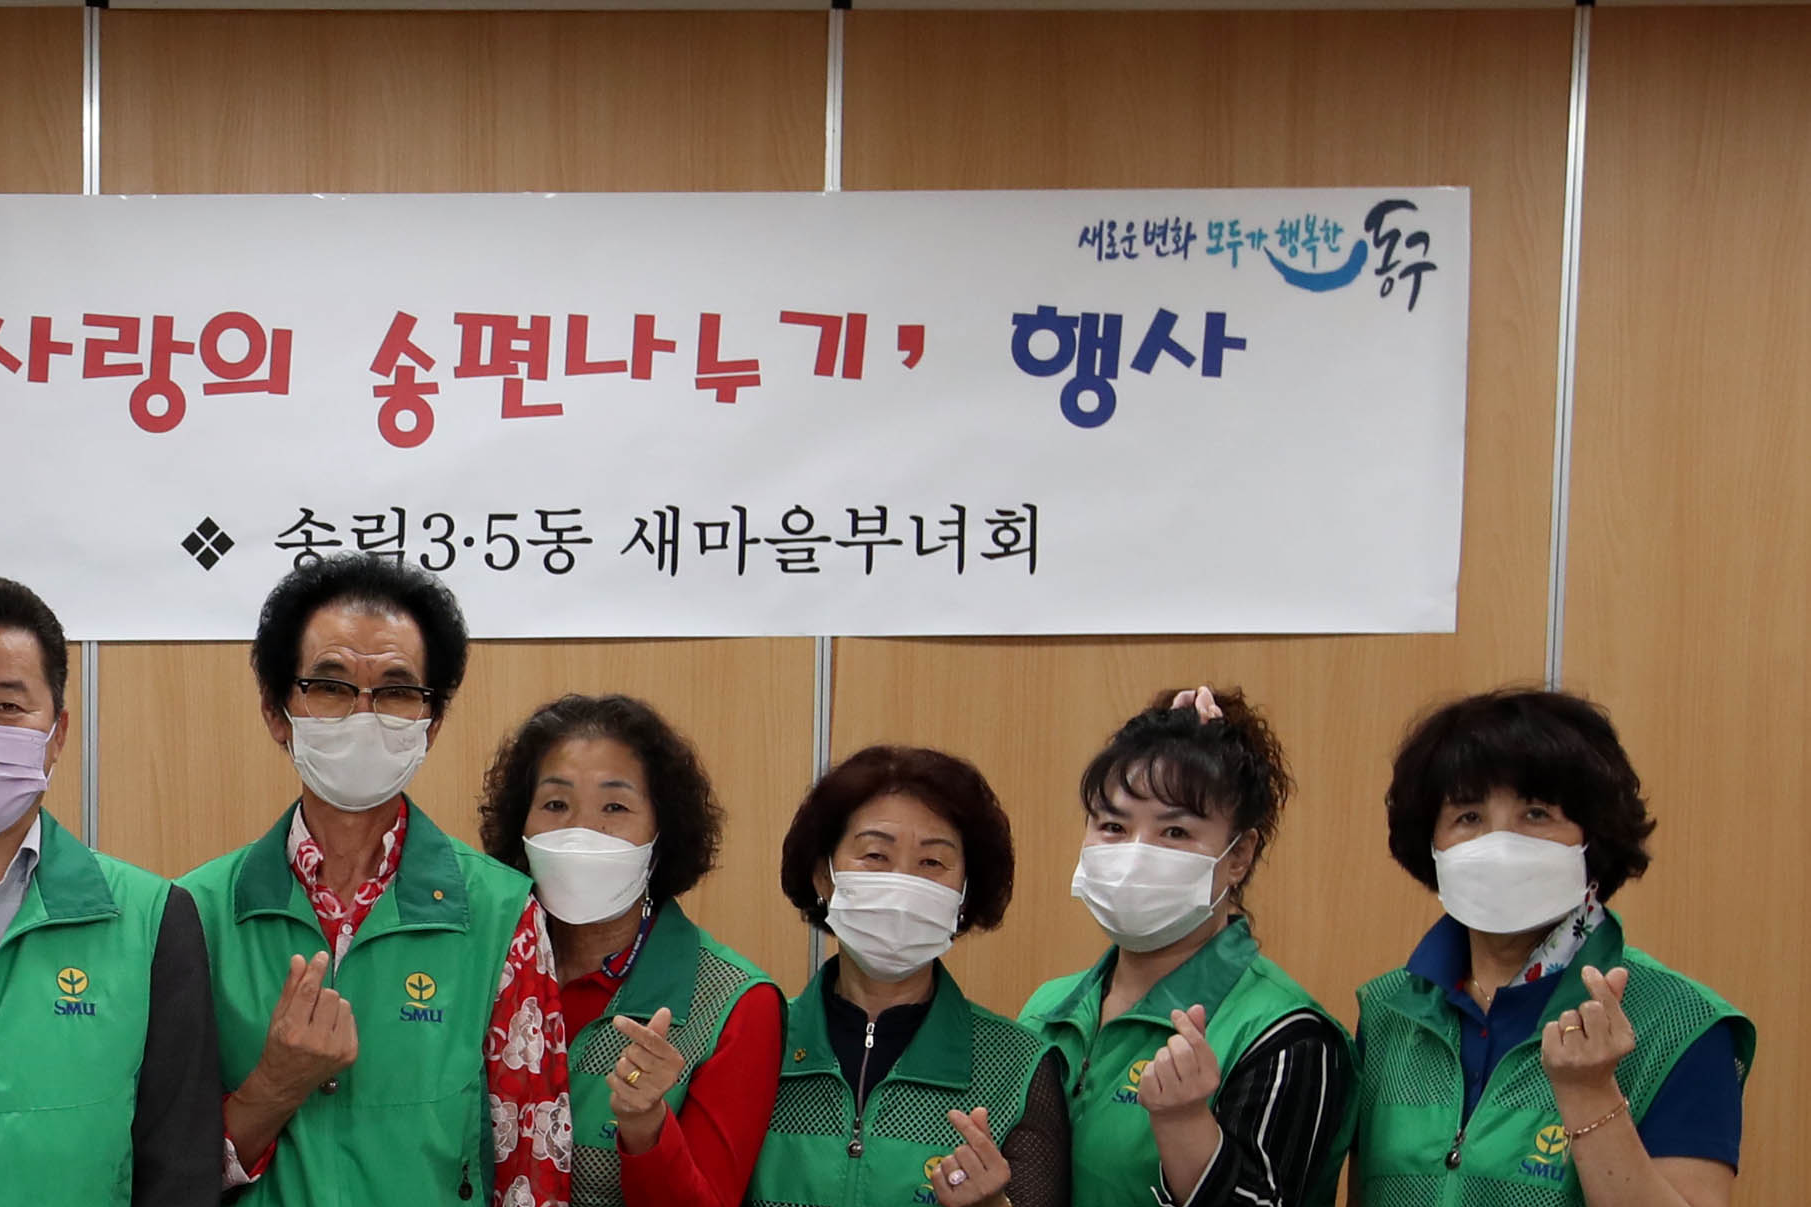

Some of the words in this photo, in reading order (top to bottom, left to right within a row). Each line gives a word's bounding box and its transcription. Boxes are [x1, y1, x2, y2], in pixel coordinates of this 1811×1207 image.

[1079, 219, 1139, 262] 새로운
[1143, 216, 1197, 260] 변화
[1206, 220, 1268, 268] 모두가
[1275, 214, 1343, 268] 행복한
[1013, 306, 1244, 428] 행사
[620, 503, 1038, 577] 새마을부녀회
[54, 1000, 95, 1016] SMU
[400, 1007, 443, 1023] SMU
[1112, 1089, 1138, 1104] SM
